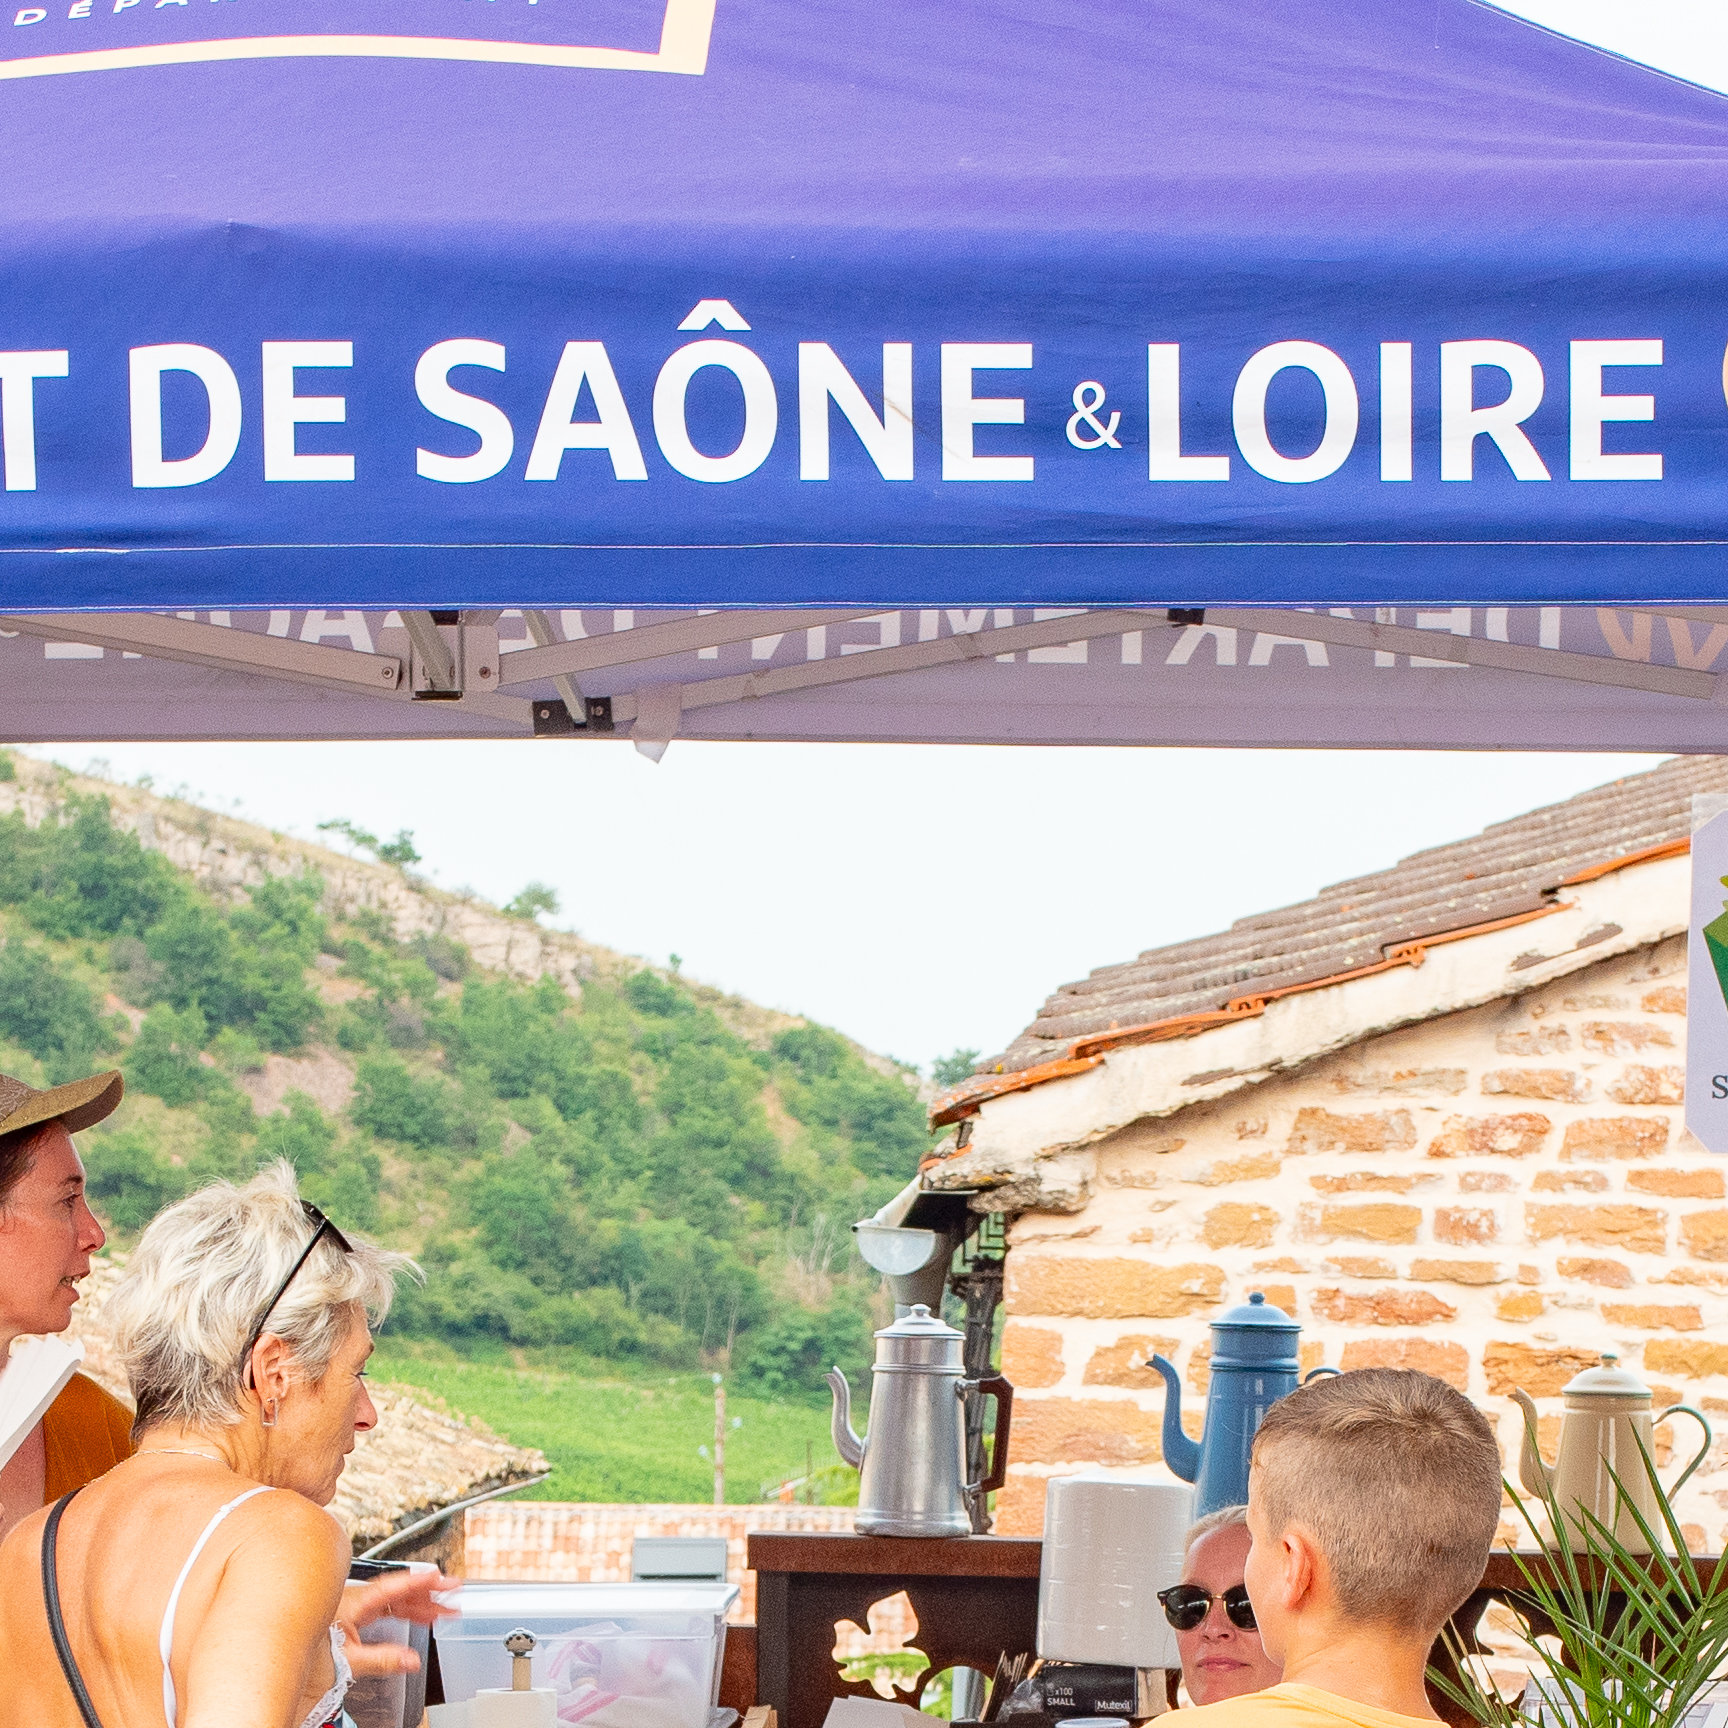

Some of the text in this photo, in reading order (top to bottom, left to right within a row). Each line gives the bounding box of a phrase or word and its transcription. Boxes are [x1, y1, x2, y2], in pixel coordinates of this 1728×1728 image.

[128, 341, 355, 489] DE
[415, 299, 1035, 484] SAÔNE
[1065, 381, 1122, 450] &
[1148, 339, 1663, 483] LOIRE
[1047, 1697, 1075, 1706] SMALL
